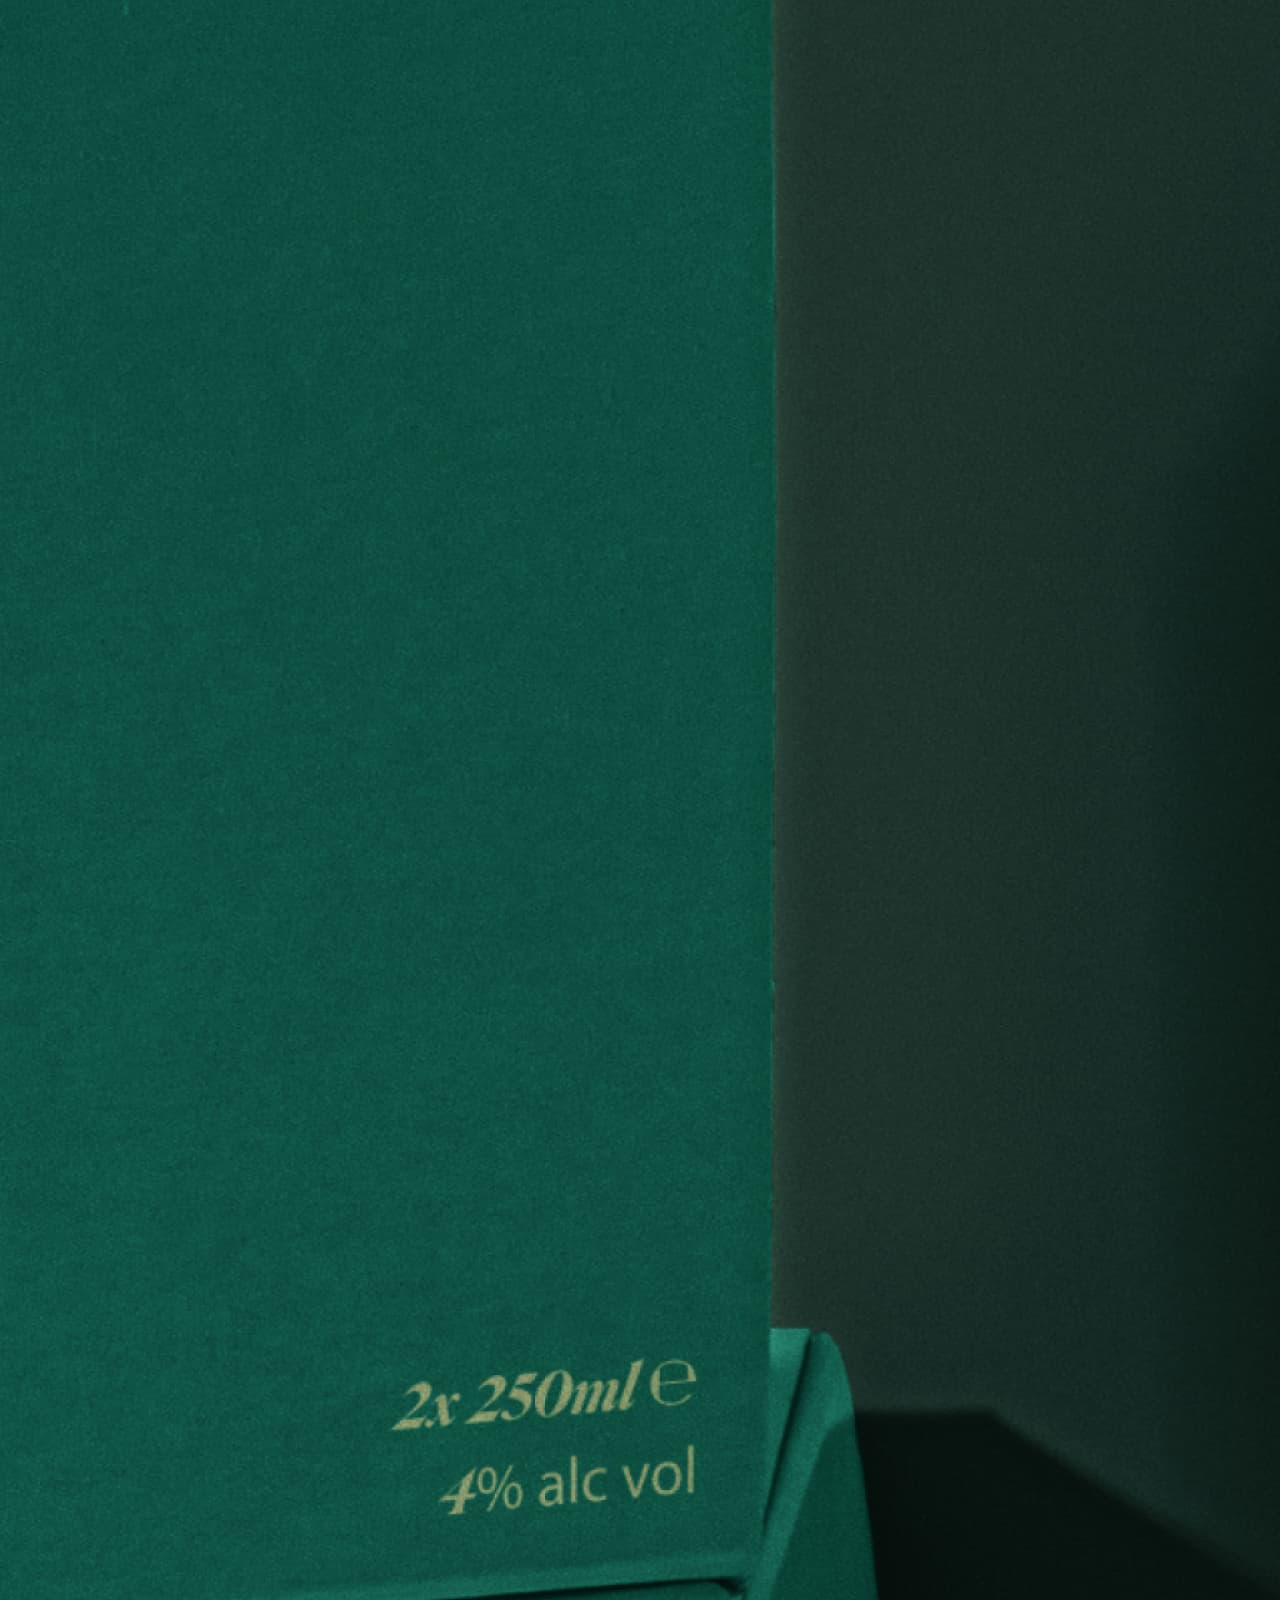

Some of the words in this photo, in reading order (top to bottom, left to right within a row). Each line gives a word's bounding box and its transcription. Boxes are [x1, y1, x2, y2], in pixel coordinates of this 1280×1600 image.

[392, 1381, 460, 1431] 2x
[466, 1358, 644, 1424] 250ml
[441, 1465, 524, 1515] 4%
[538, 1455, 607, 1507] alc
[622, 1444, 695, 1498] vol
